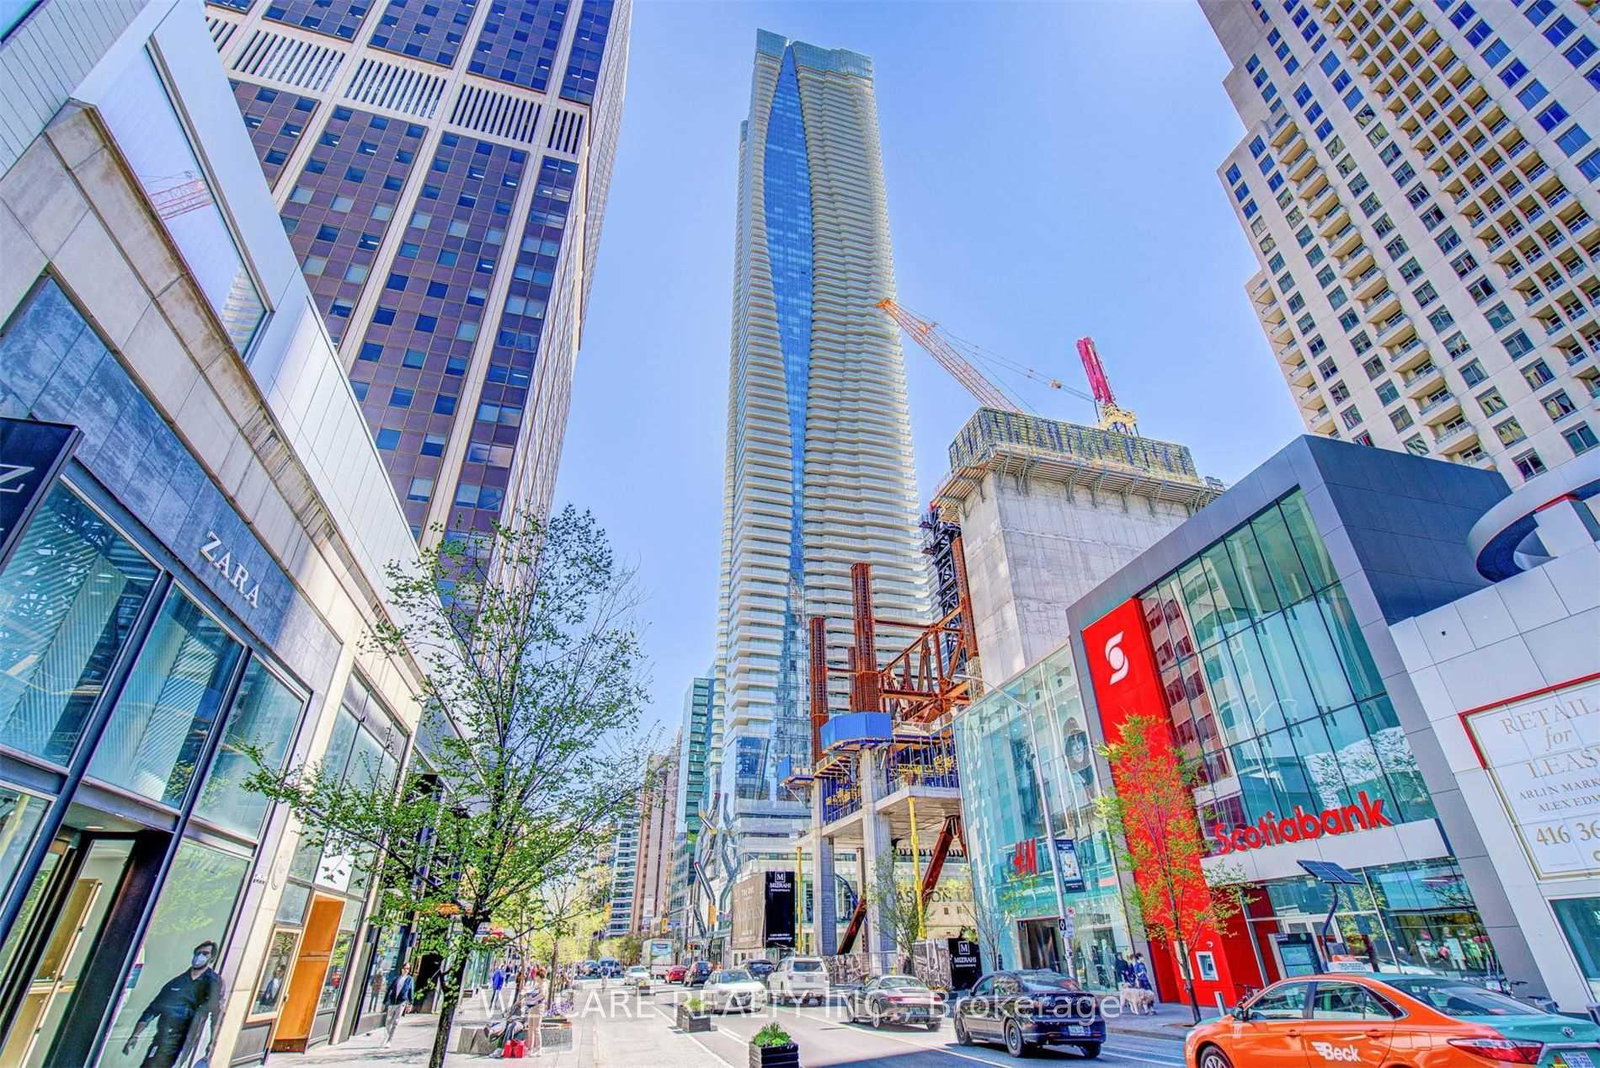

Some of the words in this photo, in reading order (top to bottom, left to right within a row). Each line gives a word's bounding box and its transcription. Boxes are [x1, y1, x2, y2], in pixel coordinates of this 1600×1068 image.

[200, 531, 260, 609] ZARA
[1501, 697, 1600, 735] RETAIL
[1545, 727, 1572, 751] for
[1527, 747, 1600, 779] LEAS
[1538, 799, 1572, 812] ALEX
[1214, 791, 1393, 855] Scotiabank
[1536, 823, 1571, 846] 416
[1322, 1042, 1361, 1063] Beck
